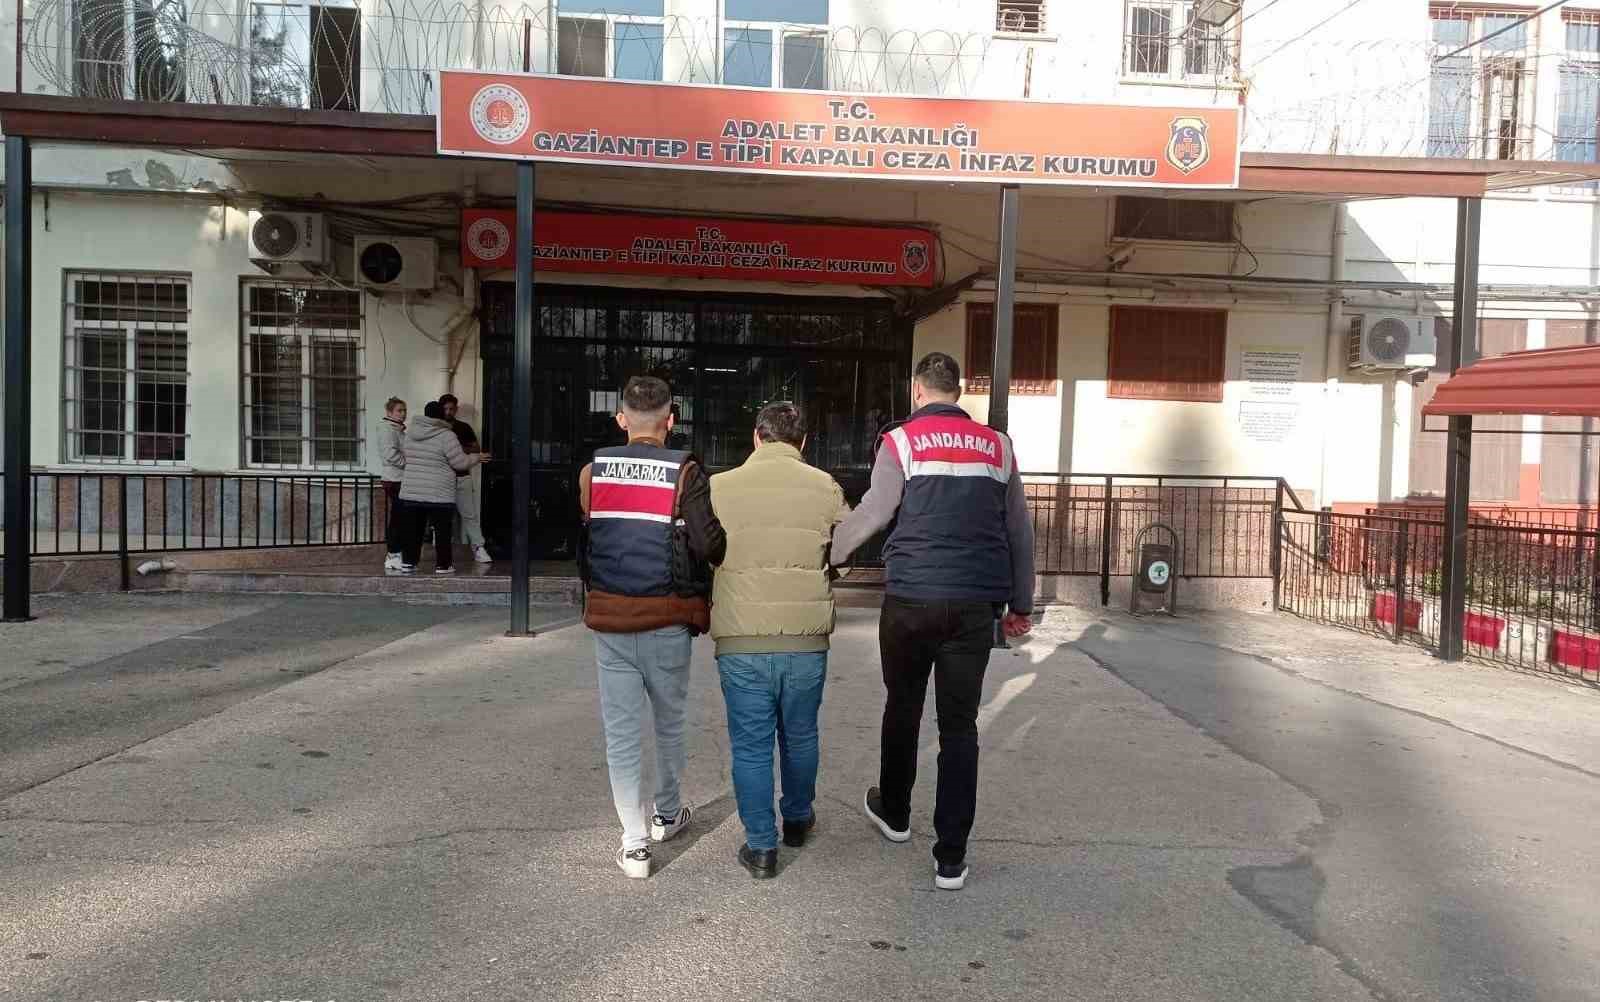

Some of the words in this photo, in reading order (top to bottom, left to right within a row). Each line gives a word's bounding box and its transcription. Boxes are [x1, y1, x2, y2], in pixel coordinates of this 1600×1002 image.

[828, 101, 876, 120] T.C.
[721, 119, 827, 142] ADALET
[834, 123, 979, 147] BAKANLIĞI
[532, 128, 688, 158] GAZİANTEP
[695, 141, 713, 160] E
[719, 137, 772, 164] TİPİ
[781, 145, 875, 168] KAPALI
[882, 149, 953, 171] CEZA
[959, 147, 1036, 173] İNFAZ
[1042, 155, 1158, 178] KURUMU
[695, 226, 726, 241] T.C.
[632, 236, 696, 252] ADALET
[700, 239, 789, 257] BAKANLIĞI
[533, 244, 614, 262] AZİANTEP
[617, 249, 629, 263] E
[668, 251, 726, 268] KAPALI
[730, 254, 772, 269] CEZA
[826, 258, 897, 274] KURUMU
[912, 431, 997, 459] JANDARMA
[600, 462, 668, 483] JANDARMA
